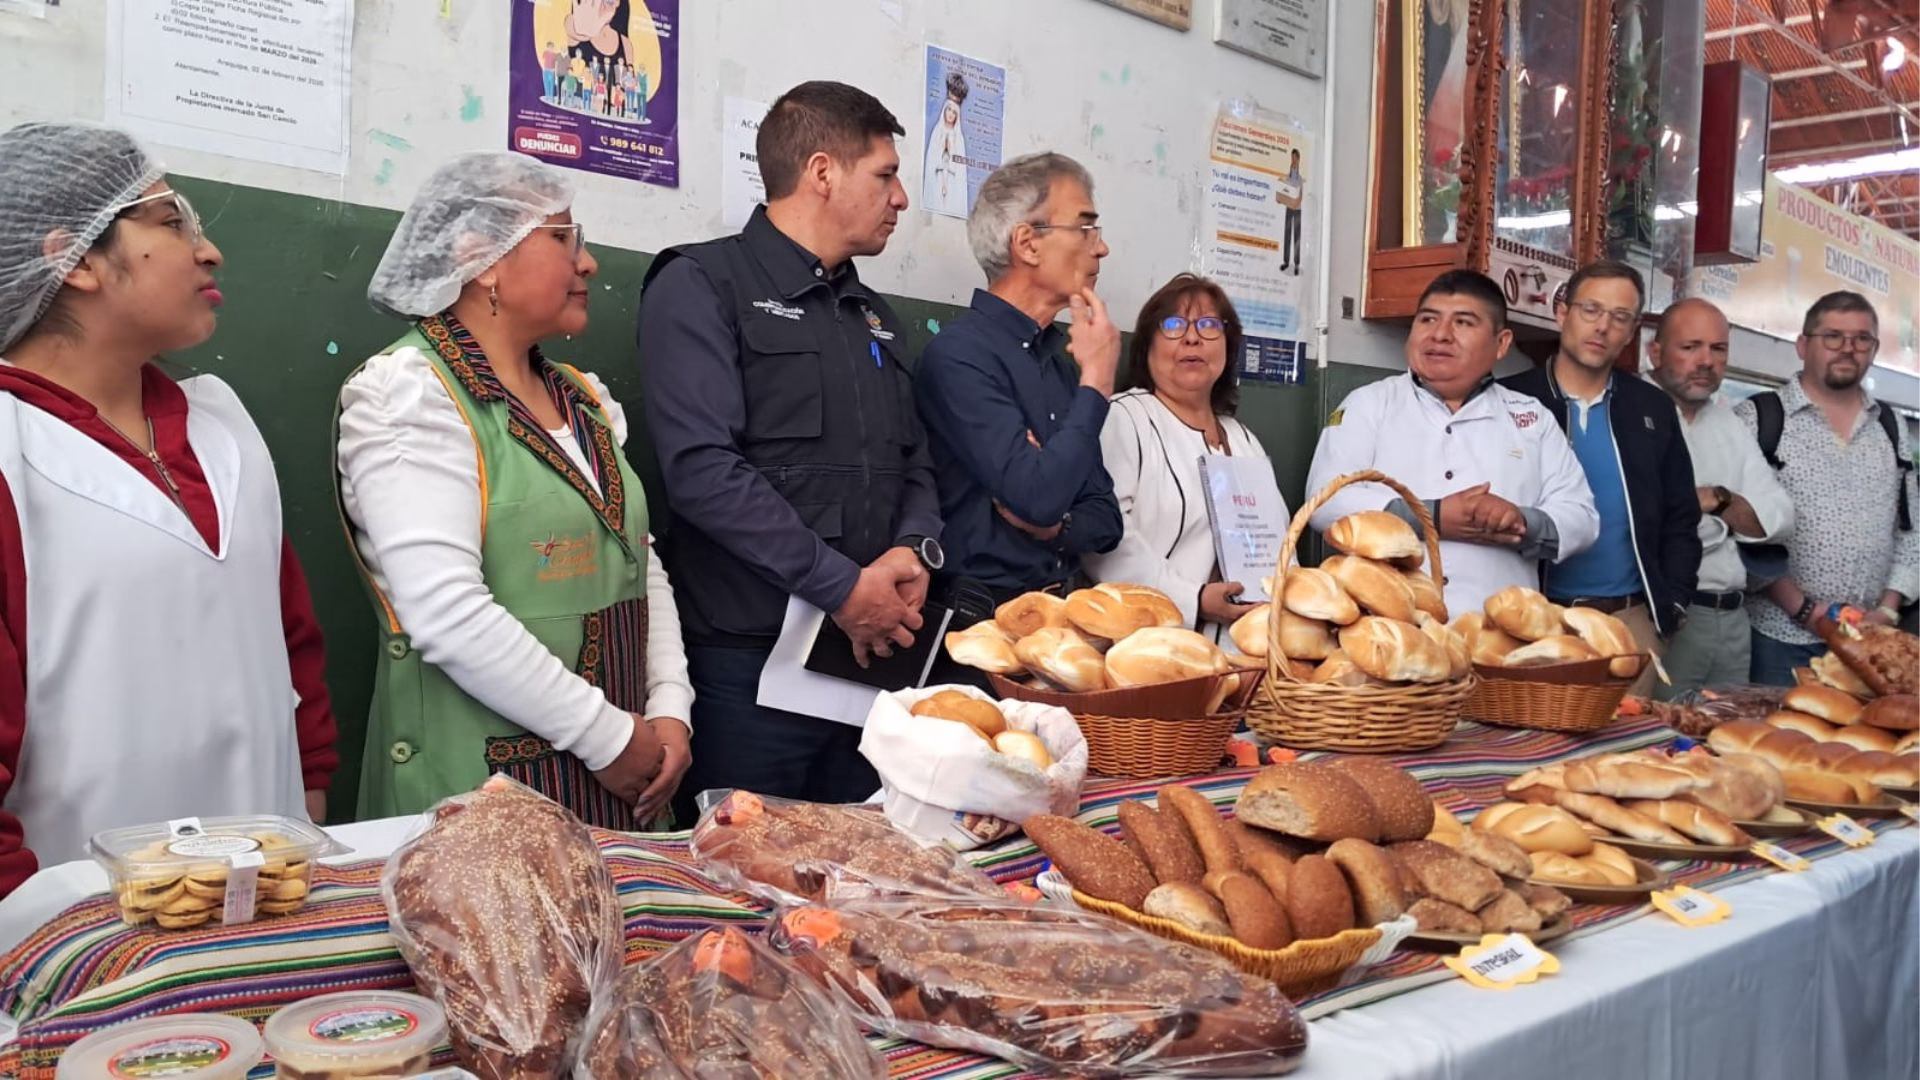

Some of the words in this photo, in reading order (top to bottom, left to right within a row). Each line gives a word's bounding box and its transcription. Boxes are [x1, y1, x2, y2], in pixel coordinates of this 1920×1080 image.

[260, 46, 288, 58] MARZO
[189, 89, 199, 97] La
[200, 91, 234, 104] Directiva
[235, 98, 245, 107] de
[255, 102, 275, 113] Junta
[276, 106, 285, 115] de
[257, 111, 271, 120] San
[272, 114, 298, 126] Camilo
[520, 137, 577, 155] DENUNCIAR
[609, 137, 628, 149] 989
[630, 141, 647, 153] 641
[648, 145, 665, 157] 812
[1777, 187, 1860, 246] PRODUCTOS
[1825, 245, 1889, 294] EMOLIENTES
